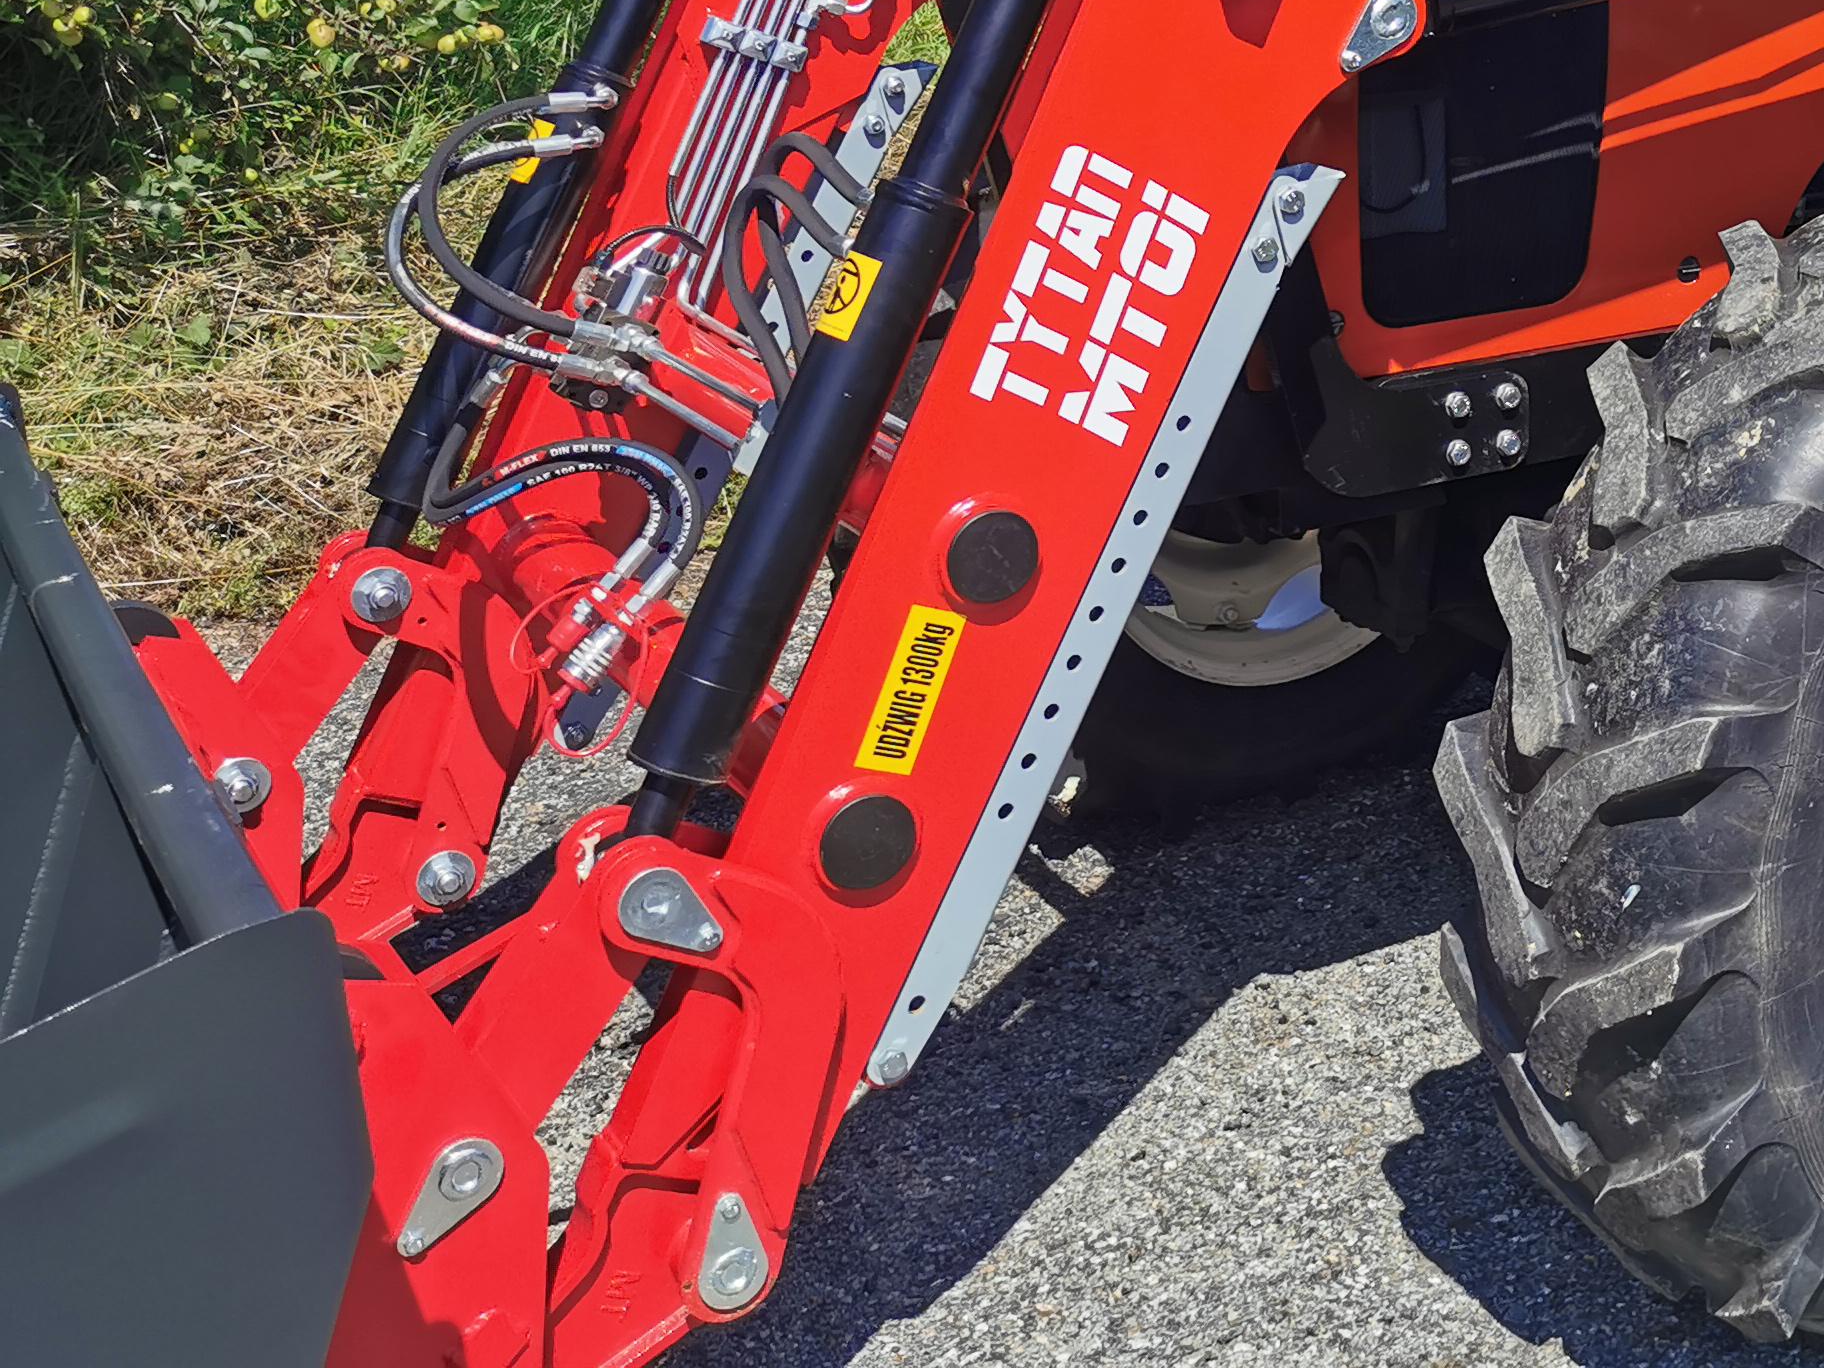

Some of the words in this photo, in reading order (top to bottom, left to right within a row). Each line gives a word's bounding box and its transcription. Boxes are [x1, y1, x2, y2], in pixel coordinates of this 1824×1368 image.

[969, 144, 1134, 406] TYTAN
[900, 622, 954, 687] 1300kg
[873, 690, 928, 759] UDŹWIG
